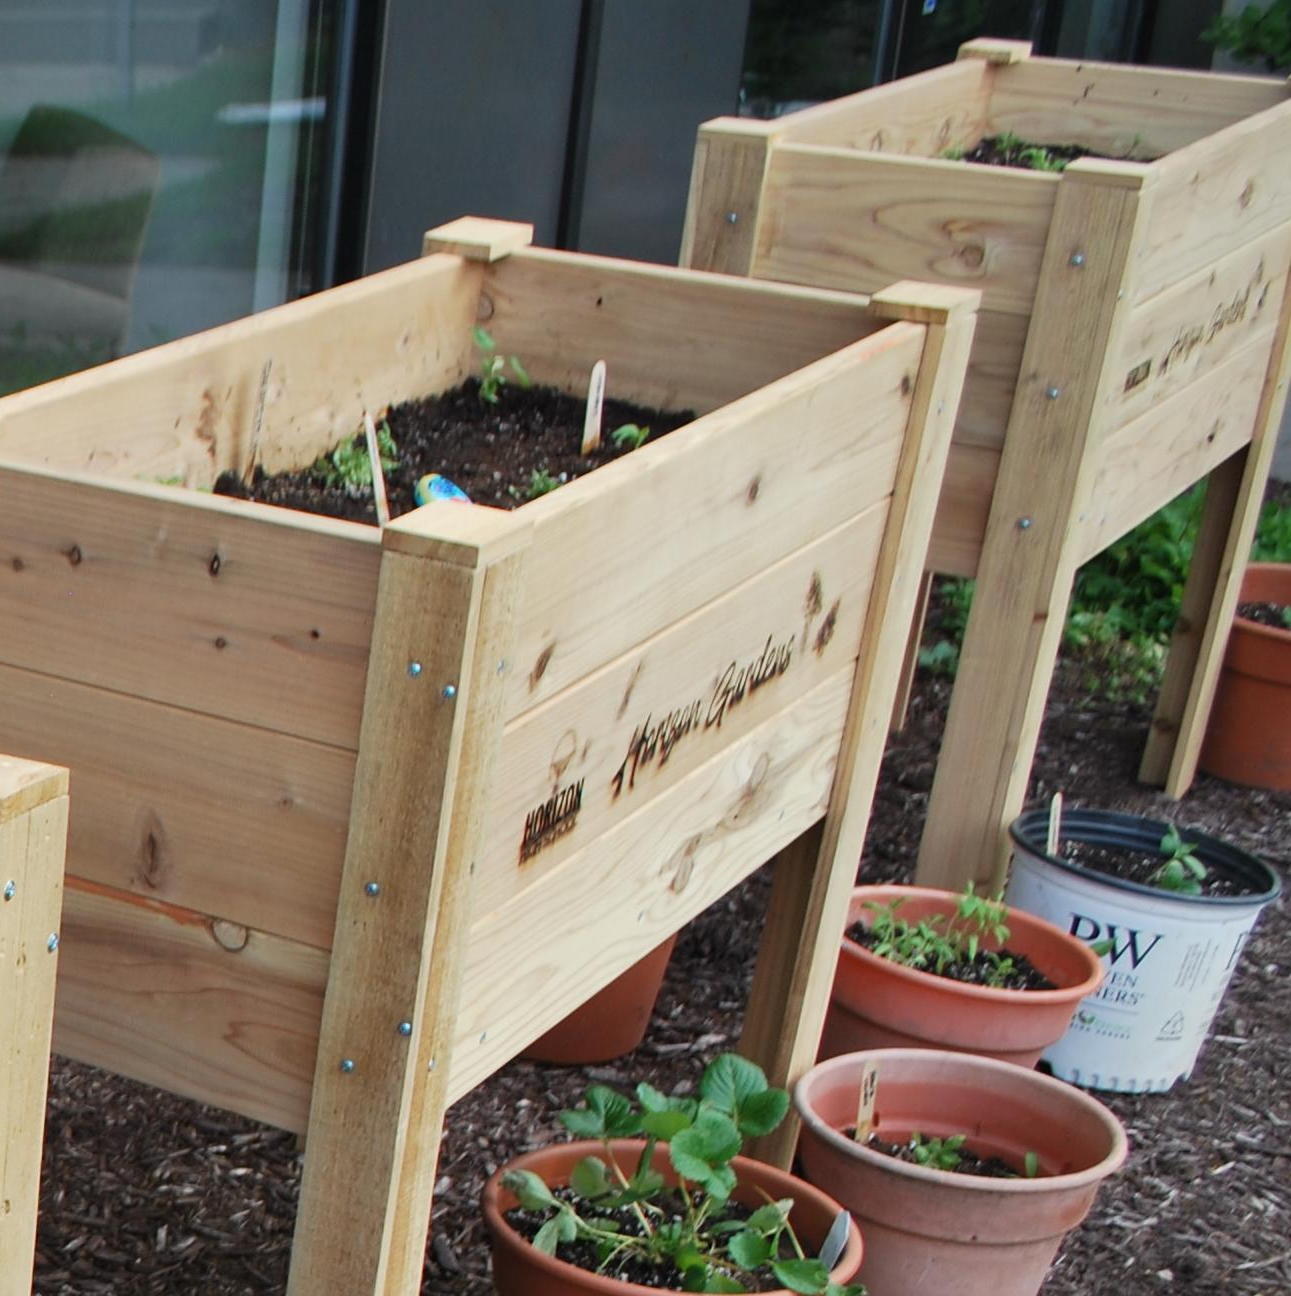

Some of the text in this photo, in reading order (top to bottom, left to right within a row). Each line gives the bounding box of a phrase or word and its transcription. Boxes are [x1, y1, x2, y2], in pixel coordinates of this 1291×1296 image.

[611, 634, 796, 801] Horizon Gardens
[1070, 913, 1166, 970] PW
